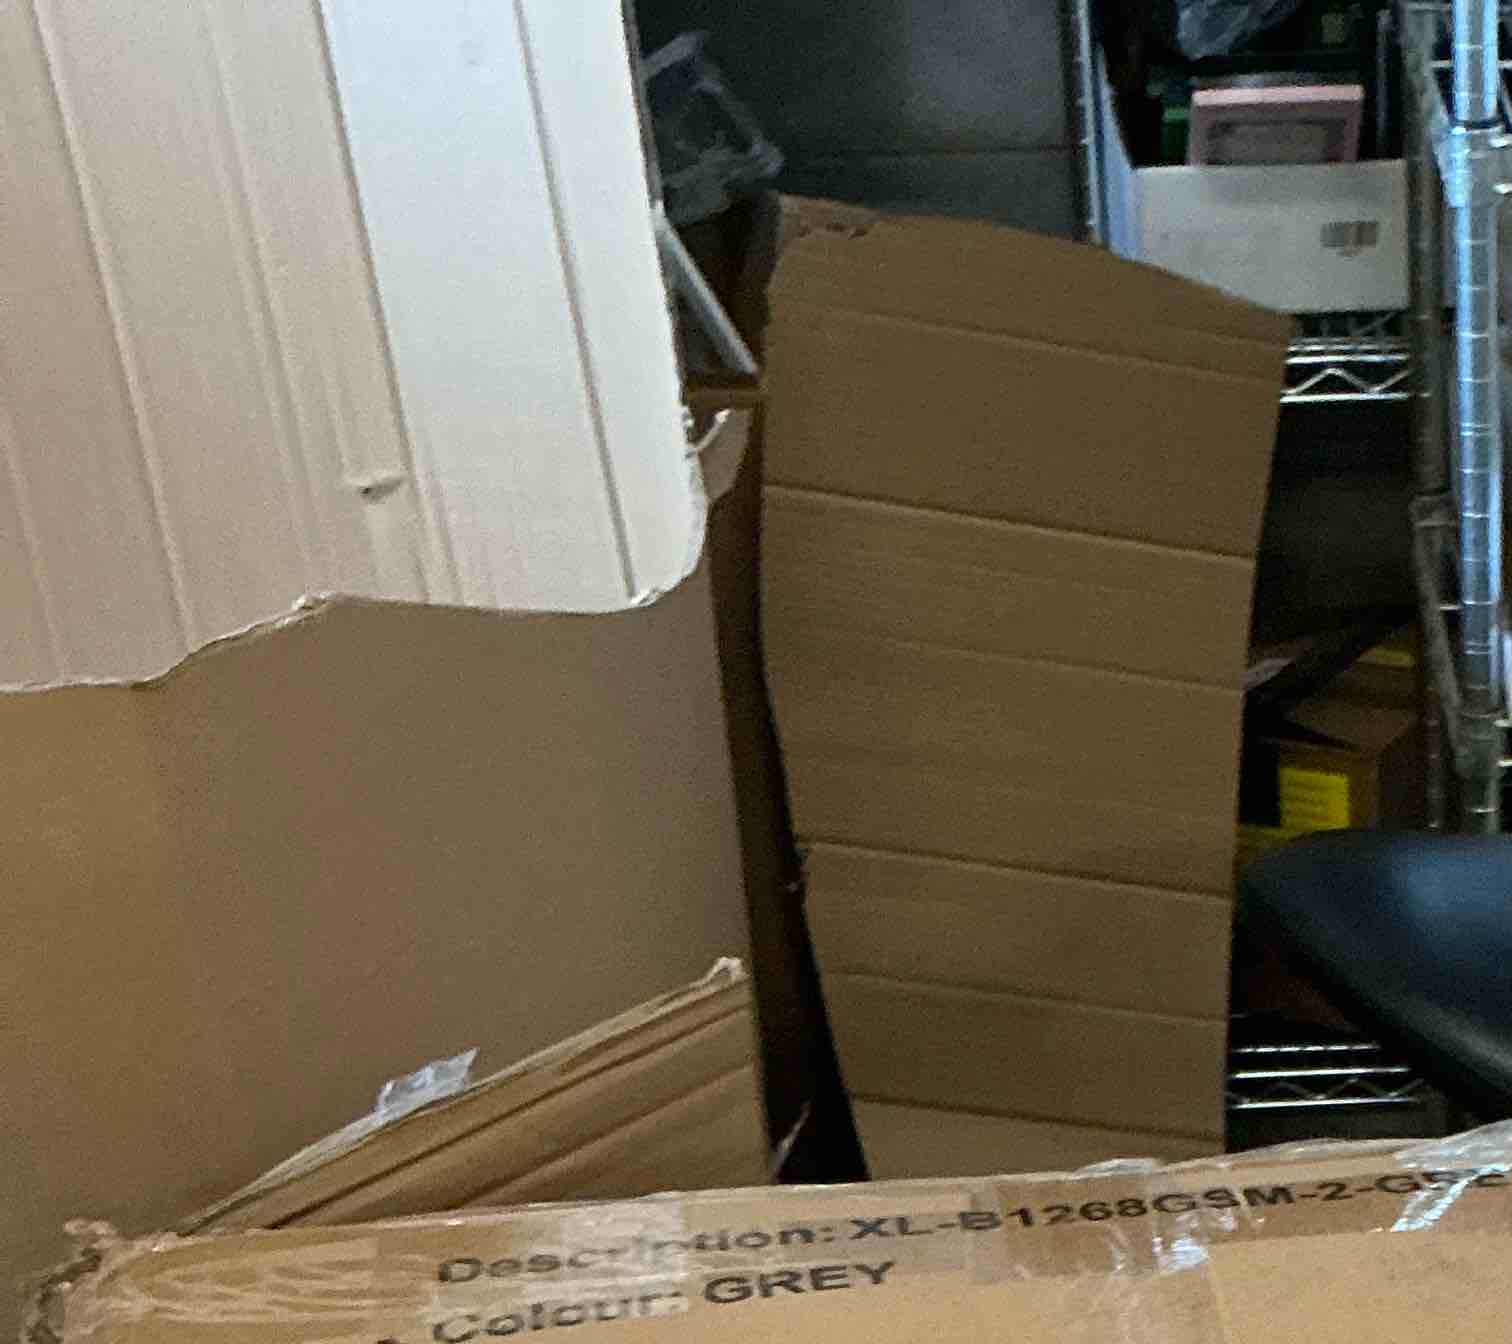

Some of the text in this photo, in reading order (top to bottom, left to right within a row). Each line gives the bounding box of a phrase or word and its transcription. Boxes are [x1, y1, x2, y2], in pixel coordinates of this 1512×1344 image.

[438, 1223, 835, 1284] Description:
[432, 1261, 895, 1344] Colour: GREY
